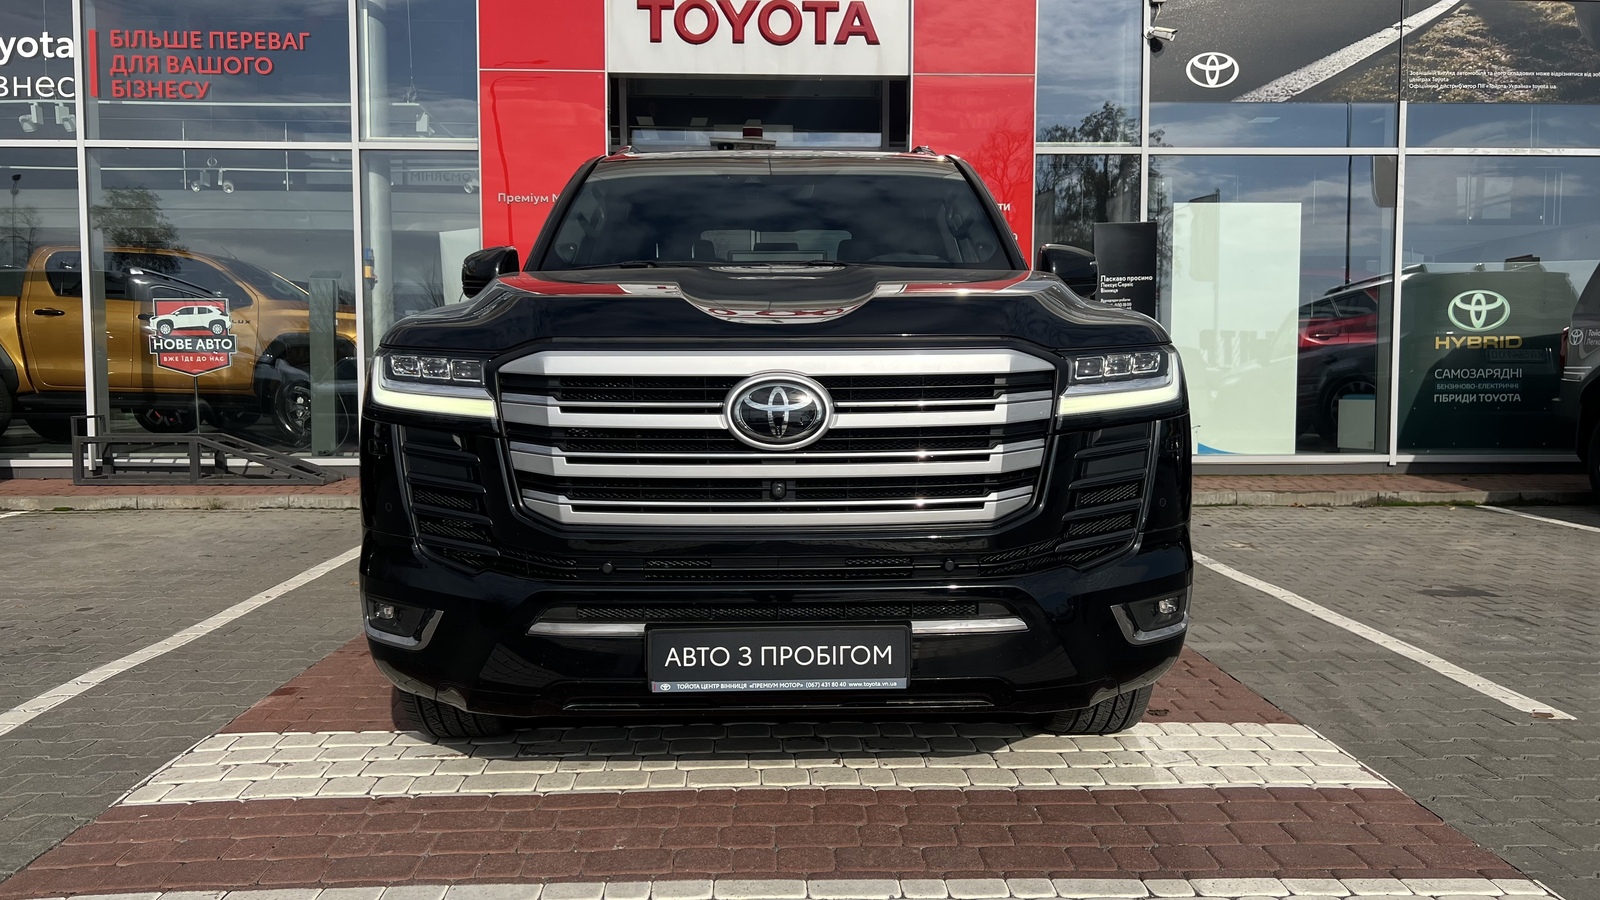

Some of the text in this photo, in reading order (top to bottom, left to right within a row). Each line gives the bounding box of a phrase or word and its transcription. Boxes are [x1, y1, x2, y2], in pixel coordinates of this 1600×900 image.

[636, 0, 881, 46] TOYOTA
[110, 29, 310, 51] БІЛЬШЕ ПЕРЕВАГ
[109, 55, 274, 76] ДЛЯ ВАШОГО
[111, 79, 210, 99] БІЗНЕСУ
[498, 192, 549, 205] Преміум
[1126, 275, 1153, 283] просимо
[153, 338, 233, 350] НОВЕ АВТО
[1435, 335, 1523, 350] HYBRID
[181, 355, 193, 363] ЇДЕ
[1434, 368, 1523, 380] САМОЗАРЯДНІ
[1434, 393, 1522, 403] ГІБРИДИ TOYOTA
[664, 645, 892, 667] АВТО З ПРОБІГОМ
[720, 682, 747, 690] ВІННИЦЯ
[805, 681, 821, 689] (067)
[848, 681, 897, 689] www.toyota.vn.ua
